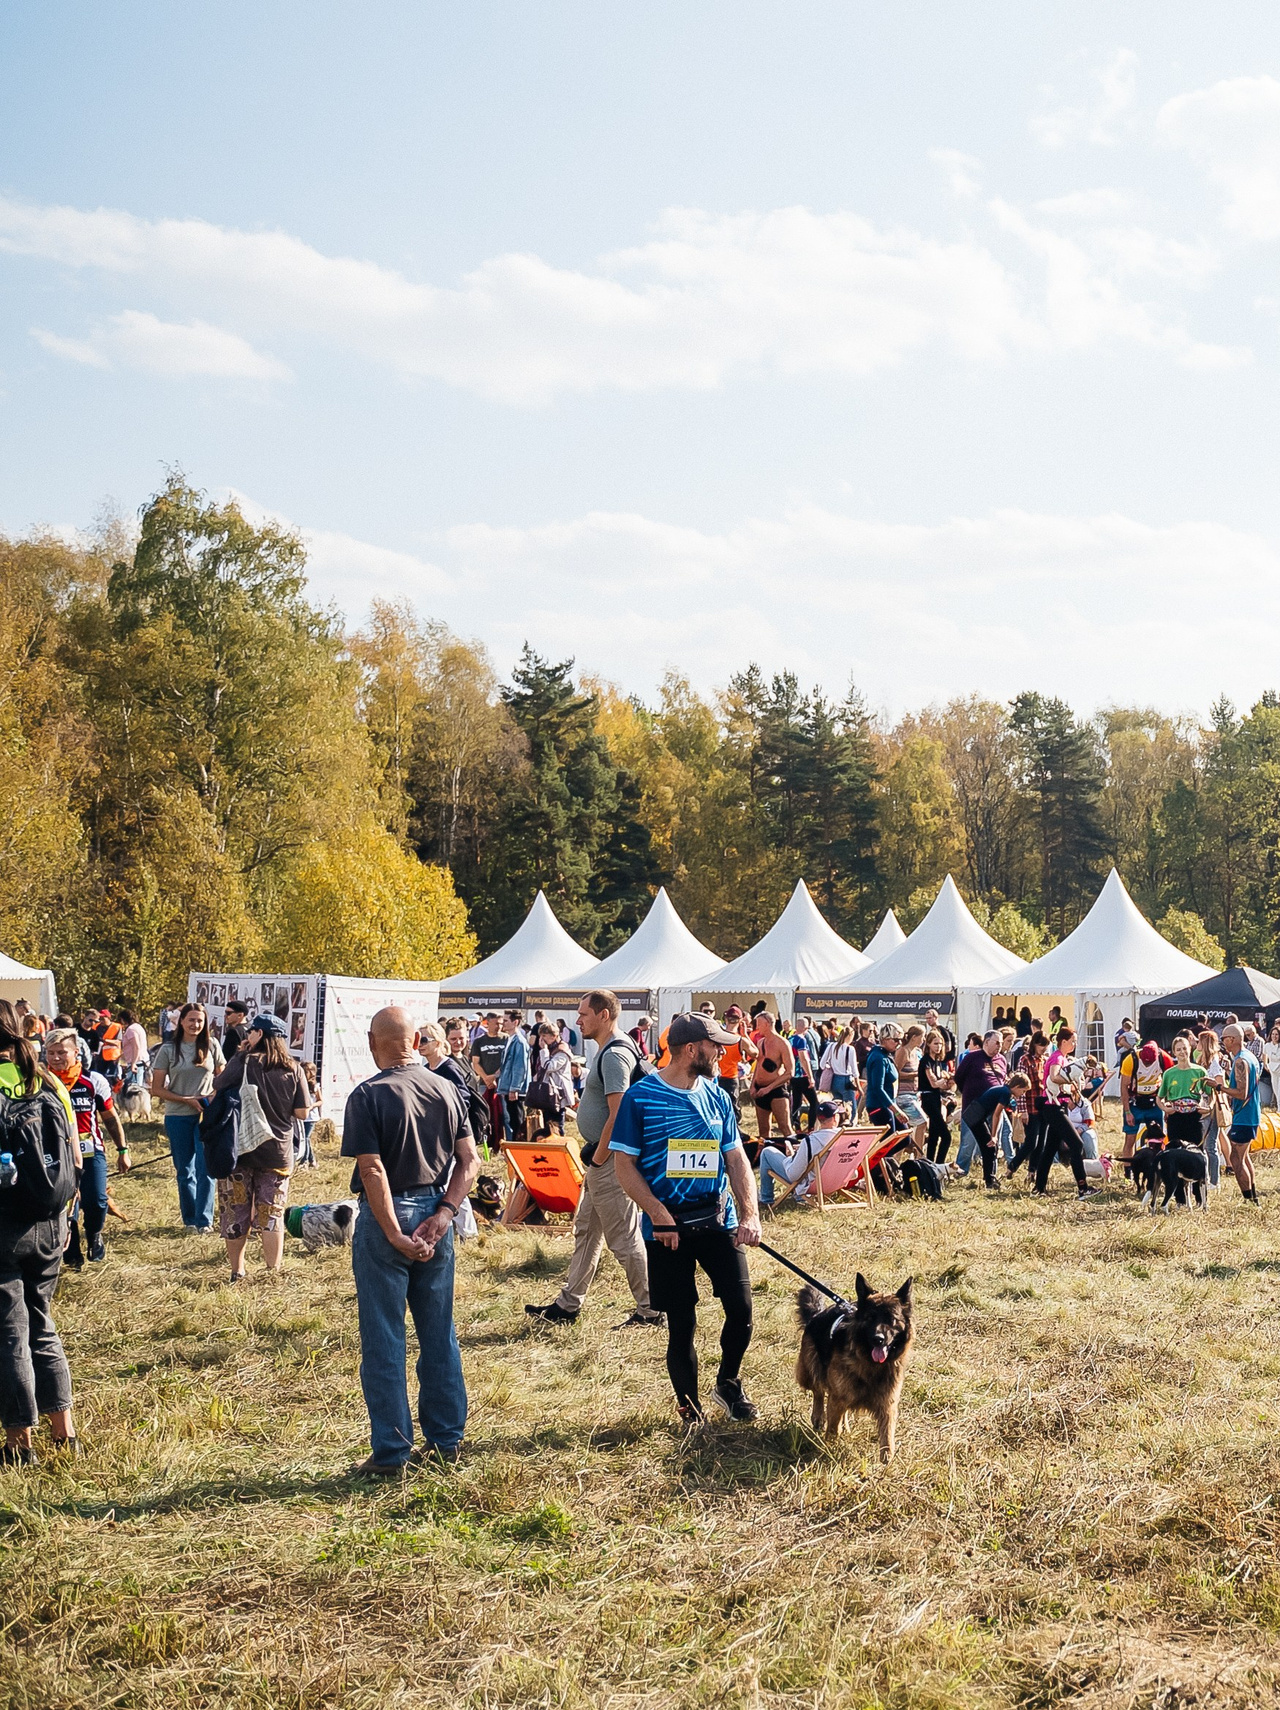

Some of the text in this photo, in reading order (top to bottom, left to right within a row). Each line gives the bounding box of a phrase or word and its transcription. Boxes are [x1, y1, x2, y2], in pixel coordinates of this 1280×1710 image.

[468, 996, 489, 1006] Changing
[805, 997, 942, 1010] Выдача номеров Race number pick-up
[679, 1153, 708, 1169] 114
